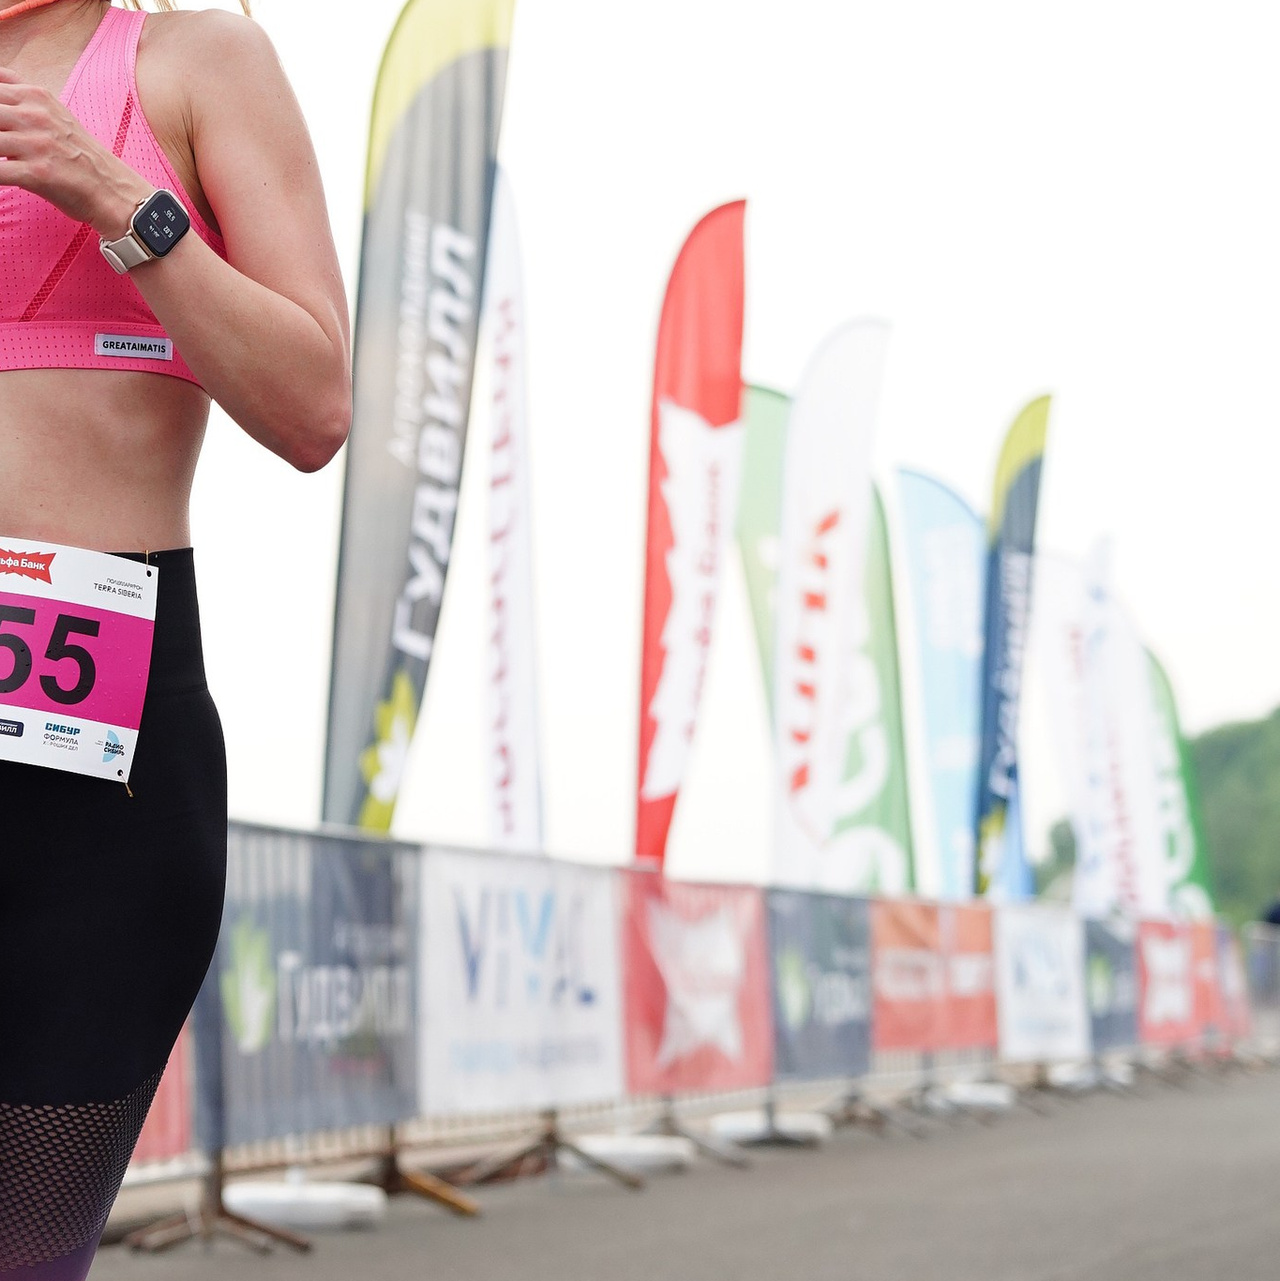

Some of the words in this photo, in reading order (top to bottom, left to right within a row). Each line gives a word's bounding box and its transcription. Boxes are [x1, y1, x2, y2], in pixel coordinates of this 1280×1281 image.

[102, 340, 166, 353] GREATAIMATIS
[20, 558, 46, 571] Банк
[93, 583, 117, 595] TERRA
[117, 588, 142, 600] SIBERIA
[45, 722, 81, 736] СИБУР
[42, 740, 68, 749] ХРОШИХ
[43, 733, 79, 746] ФОРМУЛА
[105, 741, 125, 751] РАДИО
